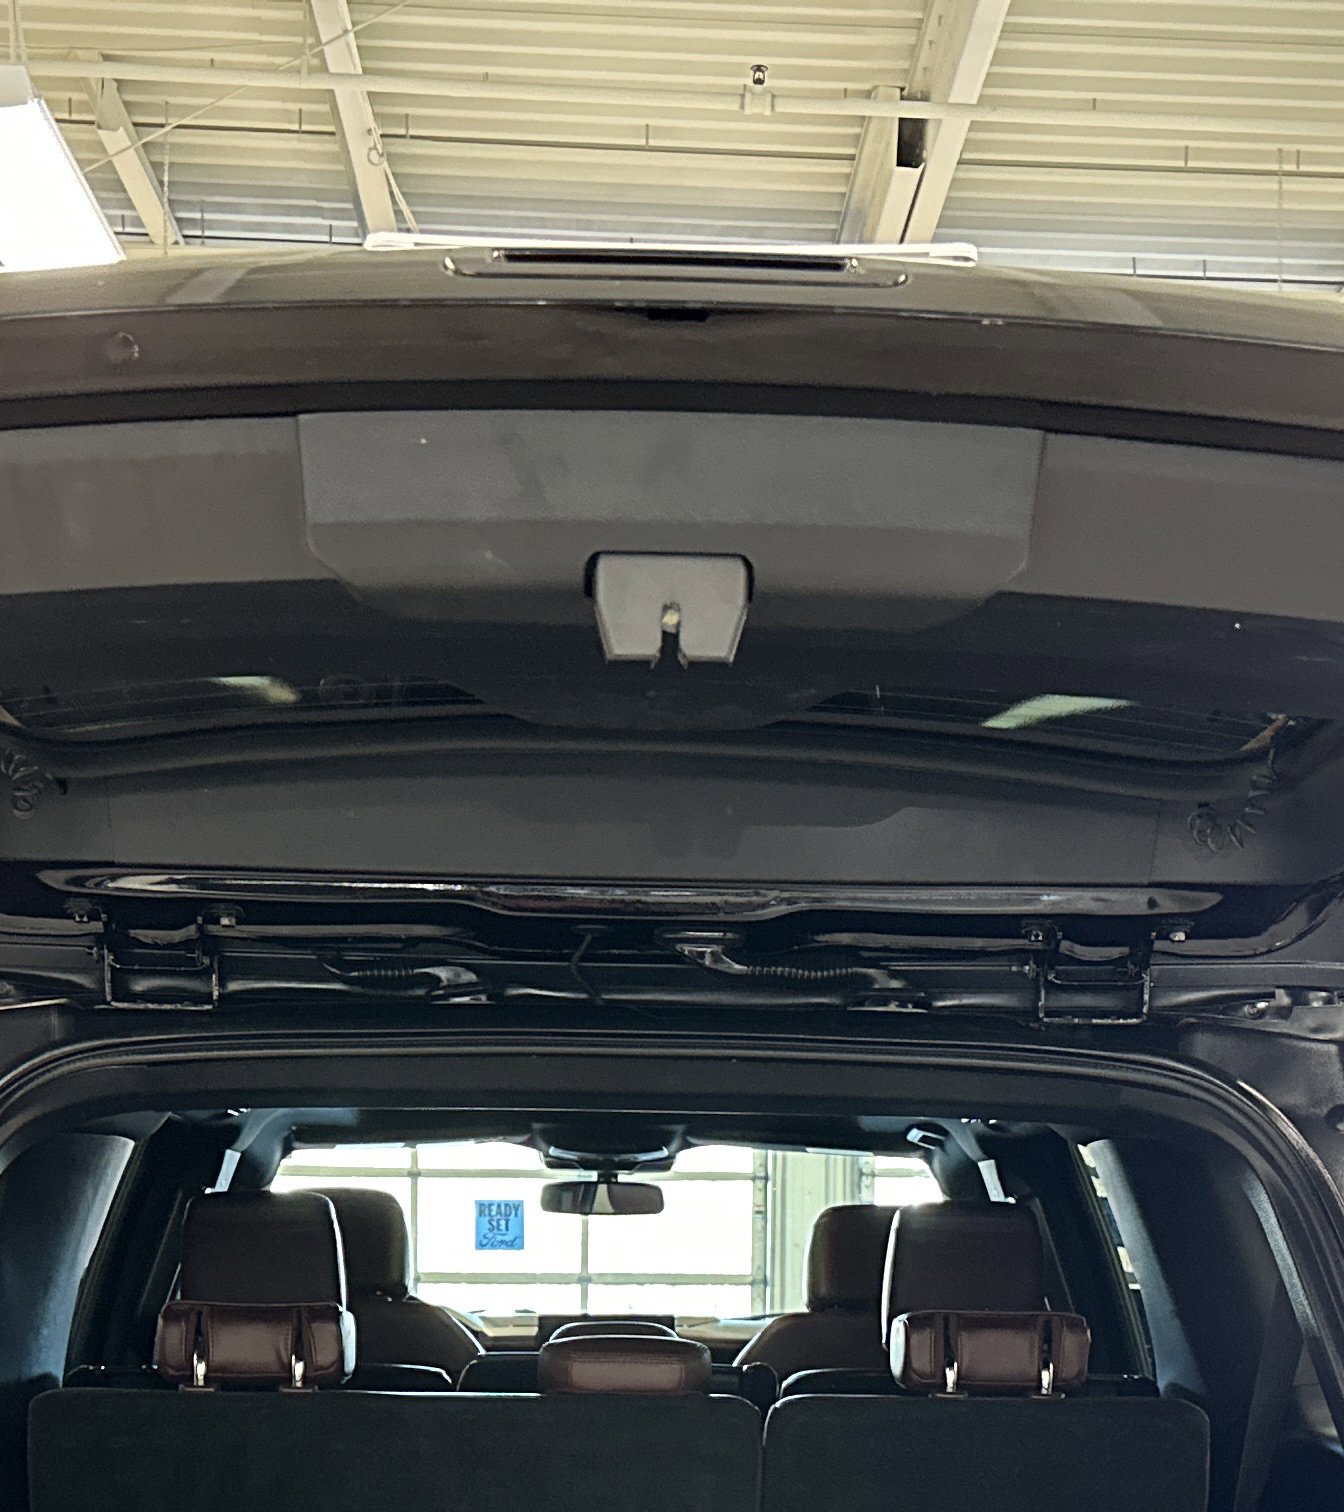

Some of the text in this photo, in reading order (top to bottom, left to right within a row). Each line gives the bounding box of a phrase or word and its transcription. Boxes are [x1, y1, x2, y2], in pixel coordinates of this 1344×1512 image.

[478, 1202, 521, 1218] READY
[487, 1218, 511, 1232] SET
[479, 1232, 518, 1248] Ford
